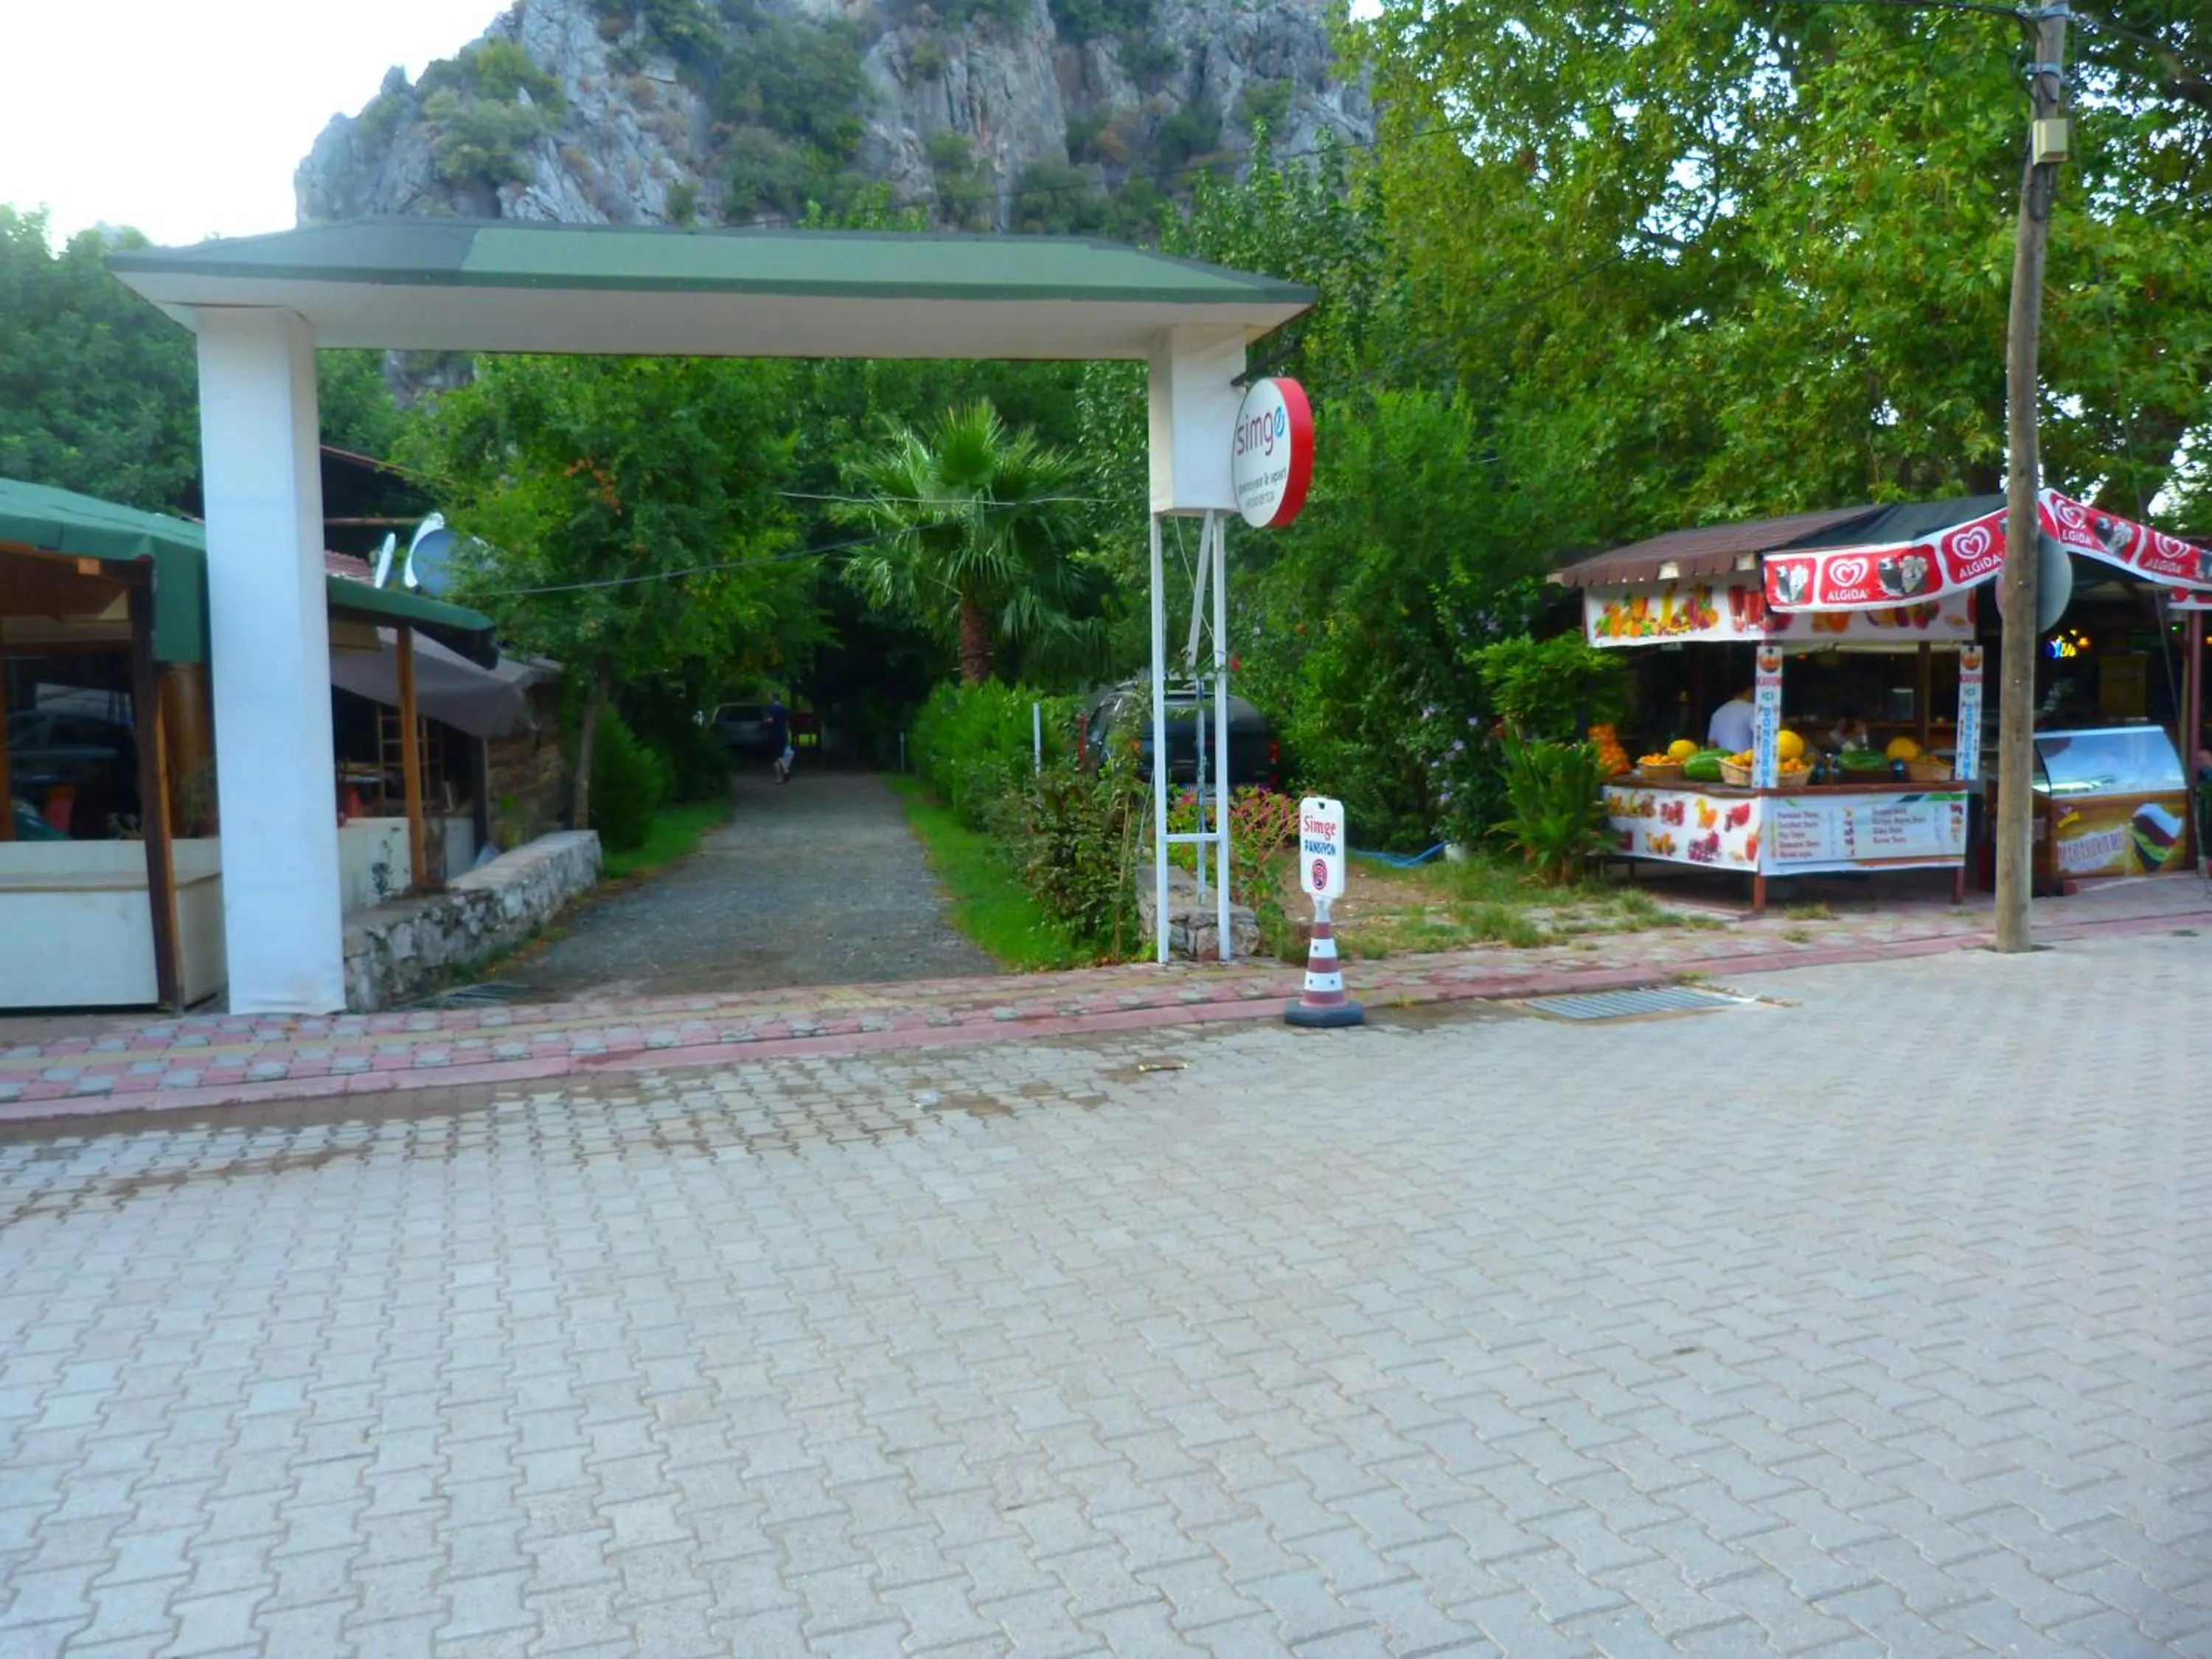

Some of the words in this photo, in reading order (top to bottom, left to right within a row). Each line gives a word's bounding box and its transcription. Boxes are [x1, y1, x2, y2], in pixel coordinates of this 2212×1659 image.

[1959, 554, 2003, 579] ALGIDA
[1827, 589, 1868, 601] ALGIDA
[1304, 815, 1336, 841] Simge
